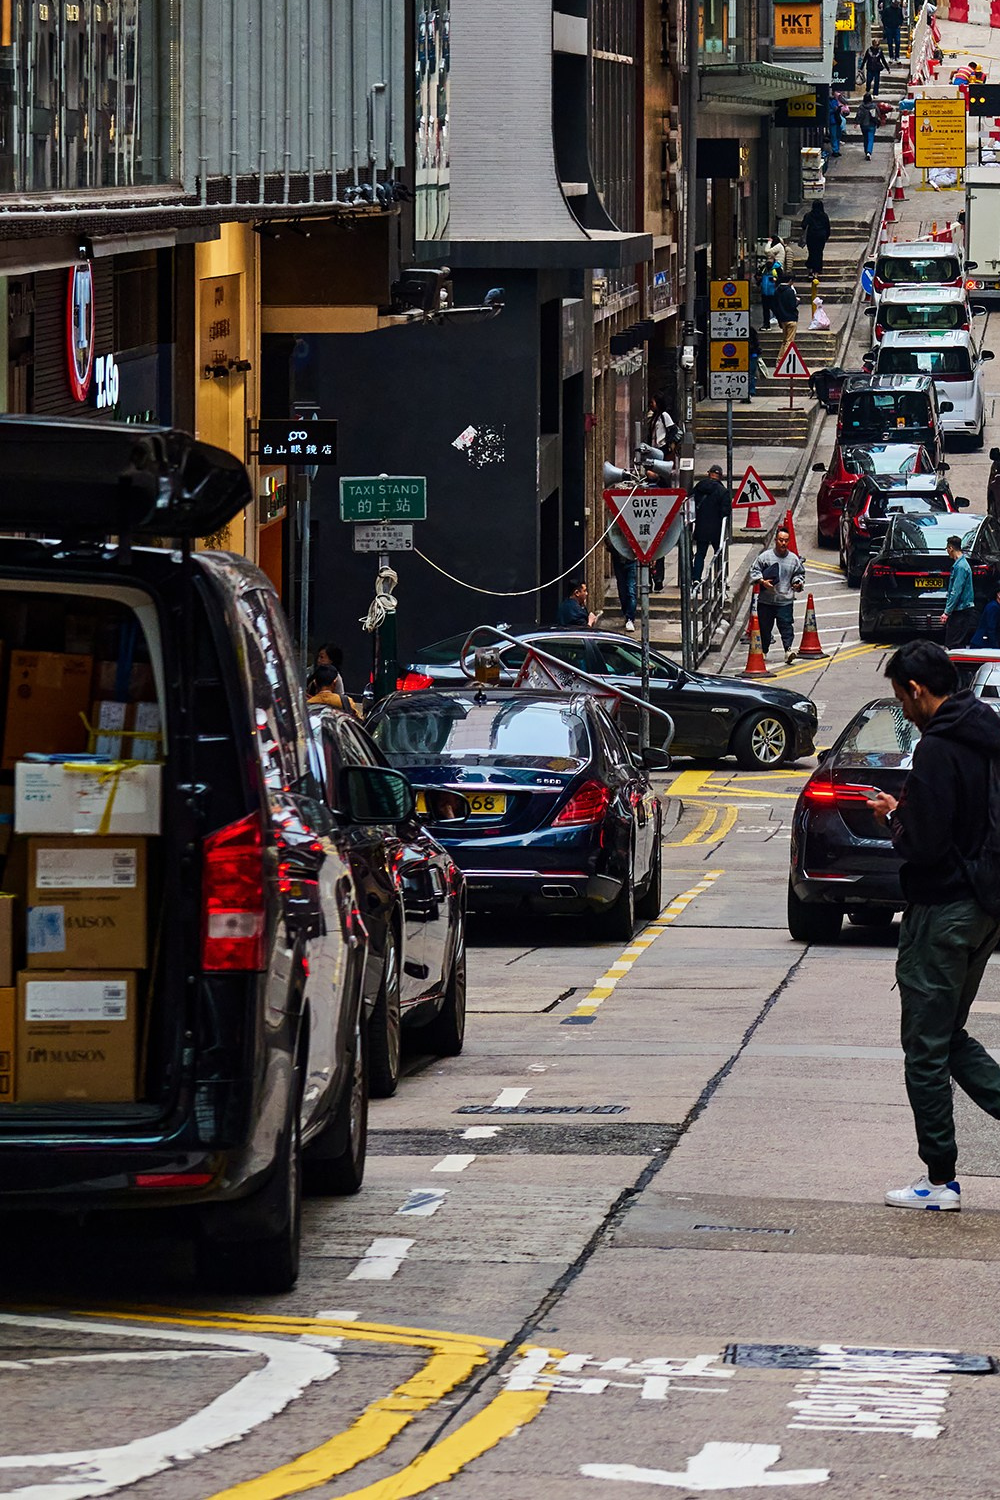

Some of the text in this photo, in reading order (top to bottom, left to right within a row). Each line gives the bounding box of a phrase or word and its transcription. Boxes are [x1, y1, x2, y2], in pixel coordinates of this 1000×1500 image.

[781, 14, 813, 27] HKT
[789, 102, 815, 111] 1010
[734, 313, 742, 322] 7
[735, 328, 748, 337] 12
[726, 375, 747, 384] 7-10
[725, 387, 742, 396] 4-7
[263, 444, 332, 455] 白山眼鏡店
[349, 484, 419, 495] TAXI STAND
[357, 498, 411, 513] 的士站
[632, 498, 658, 508] GIVE
[633, 509, 658, 518] WAY
[639, 523, 651, 536] 讓
[376, 539, 388, 548] 12
[405, 539, 412, 548] 5
[786, 1384, 950, 1439] RIGHT
